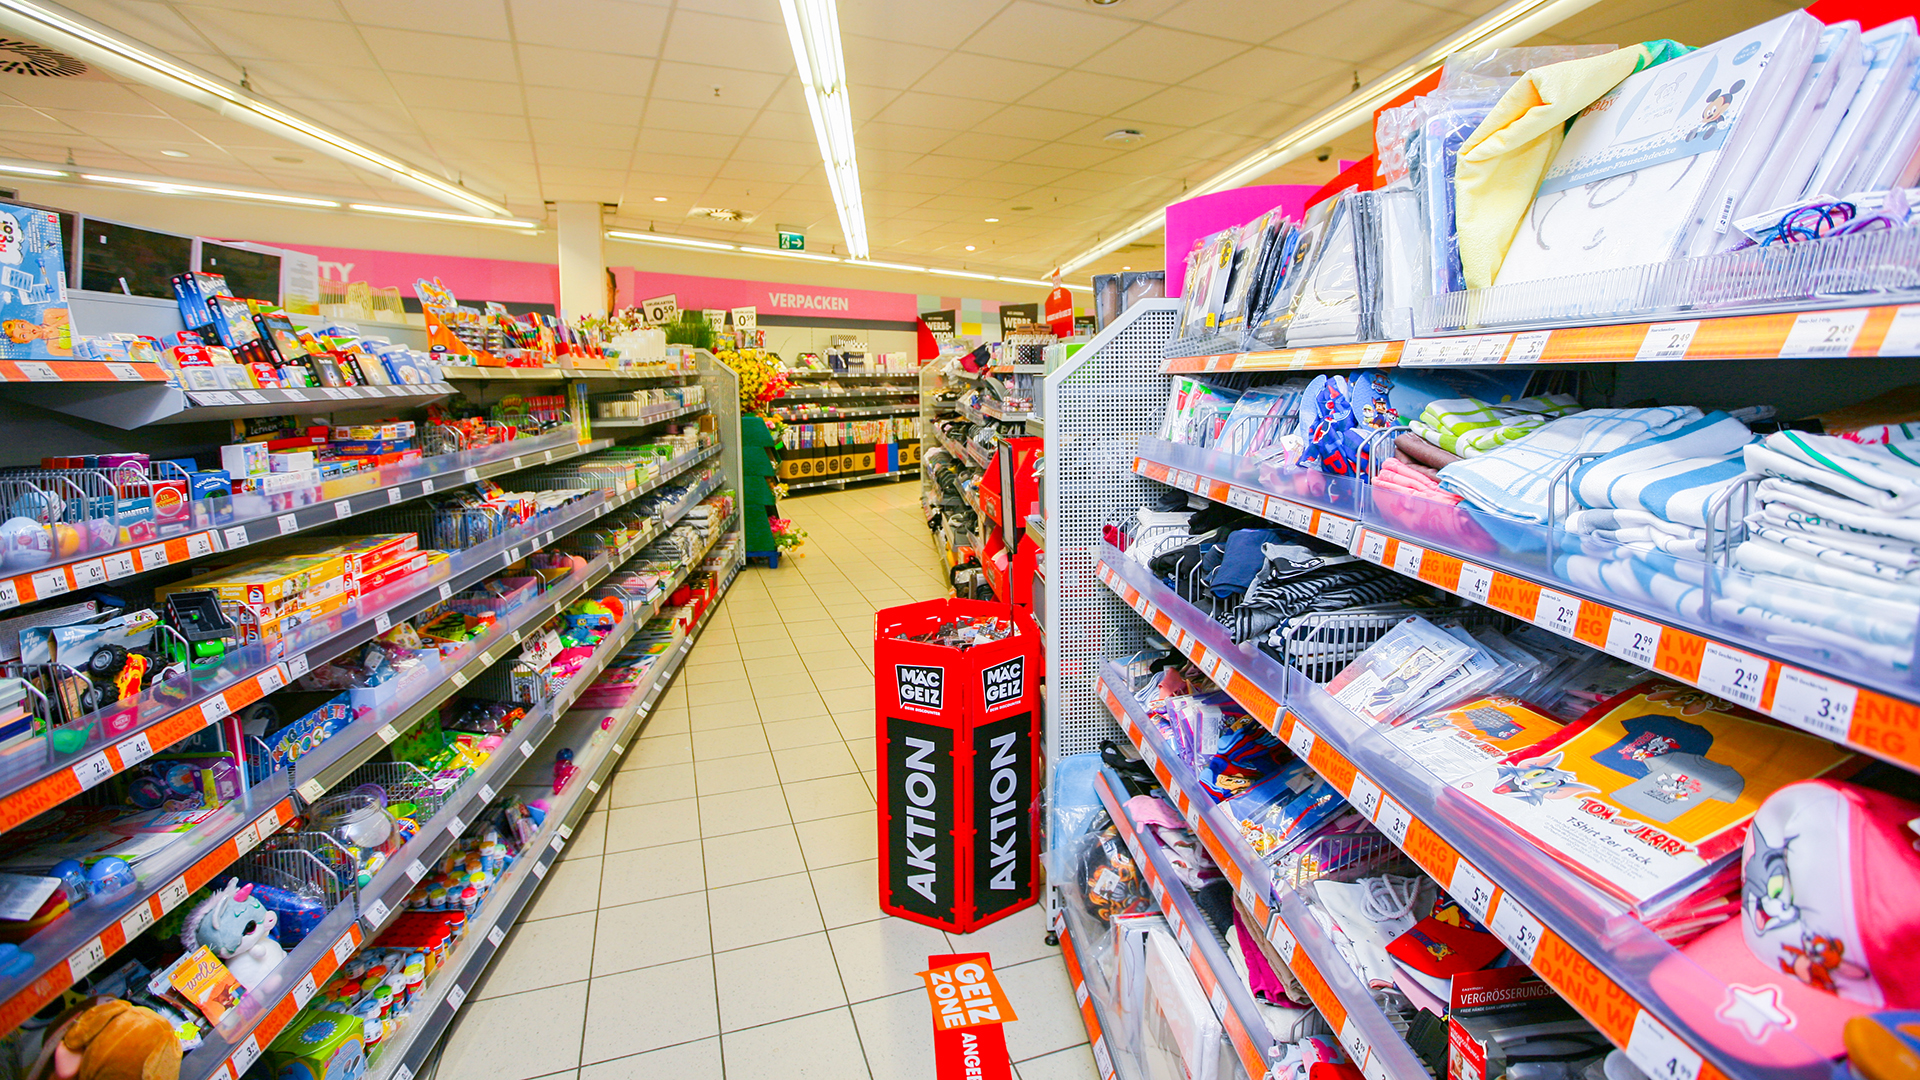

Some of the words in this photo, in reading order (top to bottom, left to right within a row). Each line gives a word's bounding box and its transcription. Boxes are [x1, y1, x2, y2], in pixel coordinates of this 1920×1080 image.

[1569, 147, 1677, 182] Microfaser-Flauschdecke
[768, 292, 849, 311] VERPACKEN
[1667, 334, 1690, 349] 2.49
[1824, 325, 1855, 343] 2.49
[1474, 578, 1488, 593] 4.99
[1556, 606, 1574, 624] 2.99
[1632, 632, 1653, 652] 2.99
[901, 668, 940, 687] MÄC
[987, 663, 1021, 685] MÄC
[1732, 668, 1759, 689] 2.49
[900, 684, 940, 705] GEIZ
[986, 680, 1021, 701] GEIZ
[915, 707, 941, 716] DISCOUNTER
[998, 700, 1021, 711] DISCOUNTER
[1817, 697, 1849, 722] 3.49
[160, 717, 186, 737] WEG
[272, 703, 347, 764] KUGEL-KNETE
[1329, 758, 1352, 785] WEG
[6, 781, 41, 807] WEG
[6, 788, 50, 826] DANN
[989, 730, 1017, 891] AKTION
[905, 736, 937, 904] AKTION
[1392, 817, 1406, 834] 3.99
[1579, 798, 1617, 821] TOM
[1624, 825, 1696, 859] JERRY
[1418, 832, 1448, 863] WEG
[1567, 816, 1600, 838] T-Shirt
[1600, 836, 1622, 849] 2er
[1621, 847, 1652, 866] Pack
[1471, 886, 1489, 906] 5.99
[1516, 925, 1536, 947] 5.99
[1553, 940, 1600, 986] WEG
[180, 961, 223, 992] wolle
[1539, 956, 1600, 1013] DANN
[930, 970, 966, 1028] ZONE
[954, 963, 1001, 1024] GEIZ
